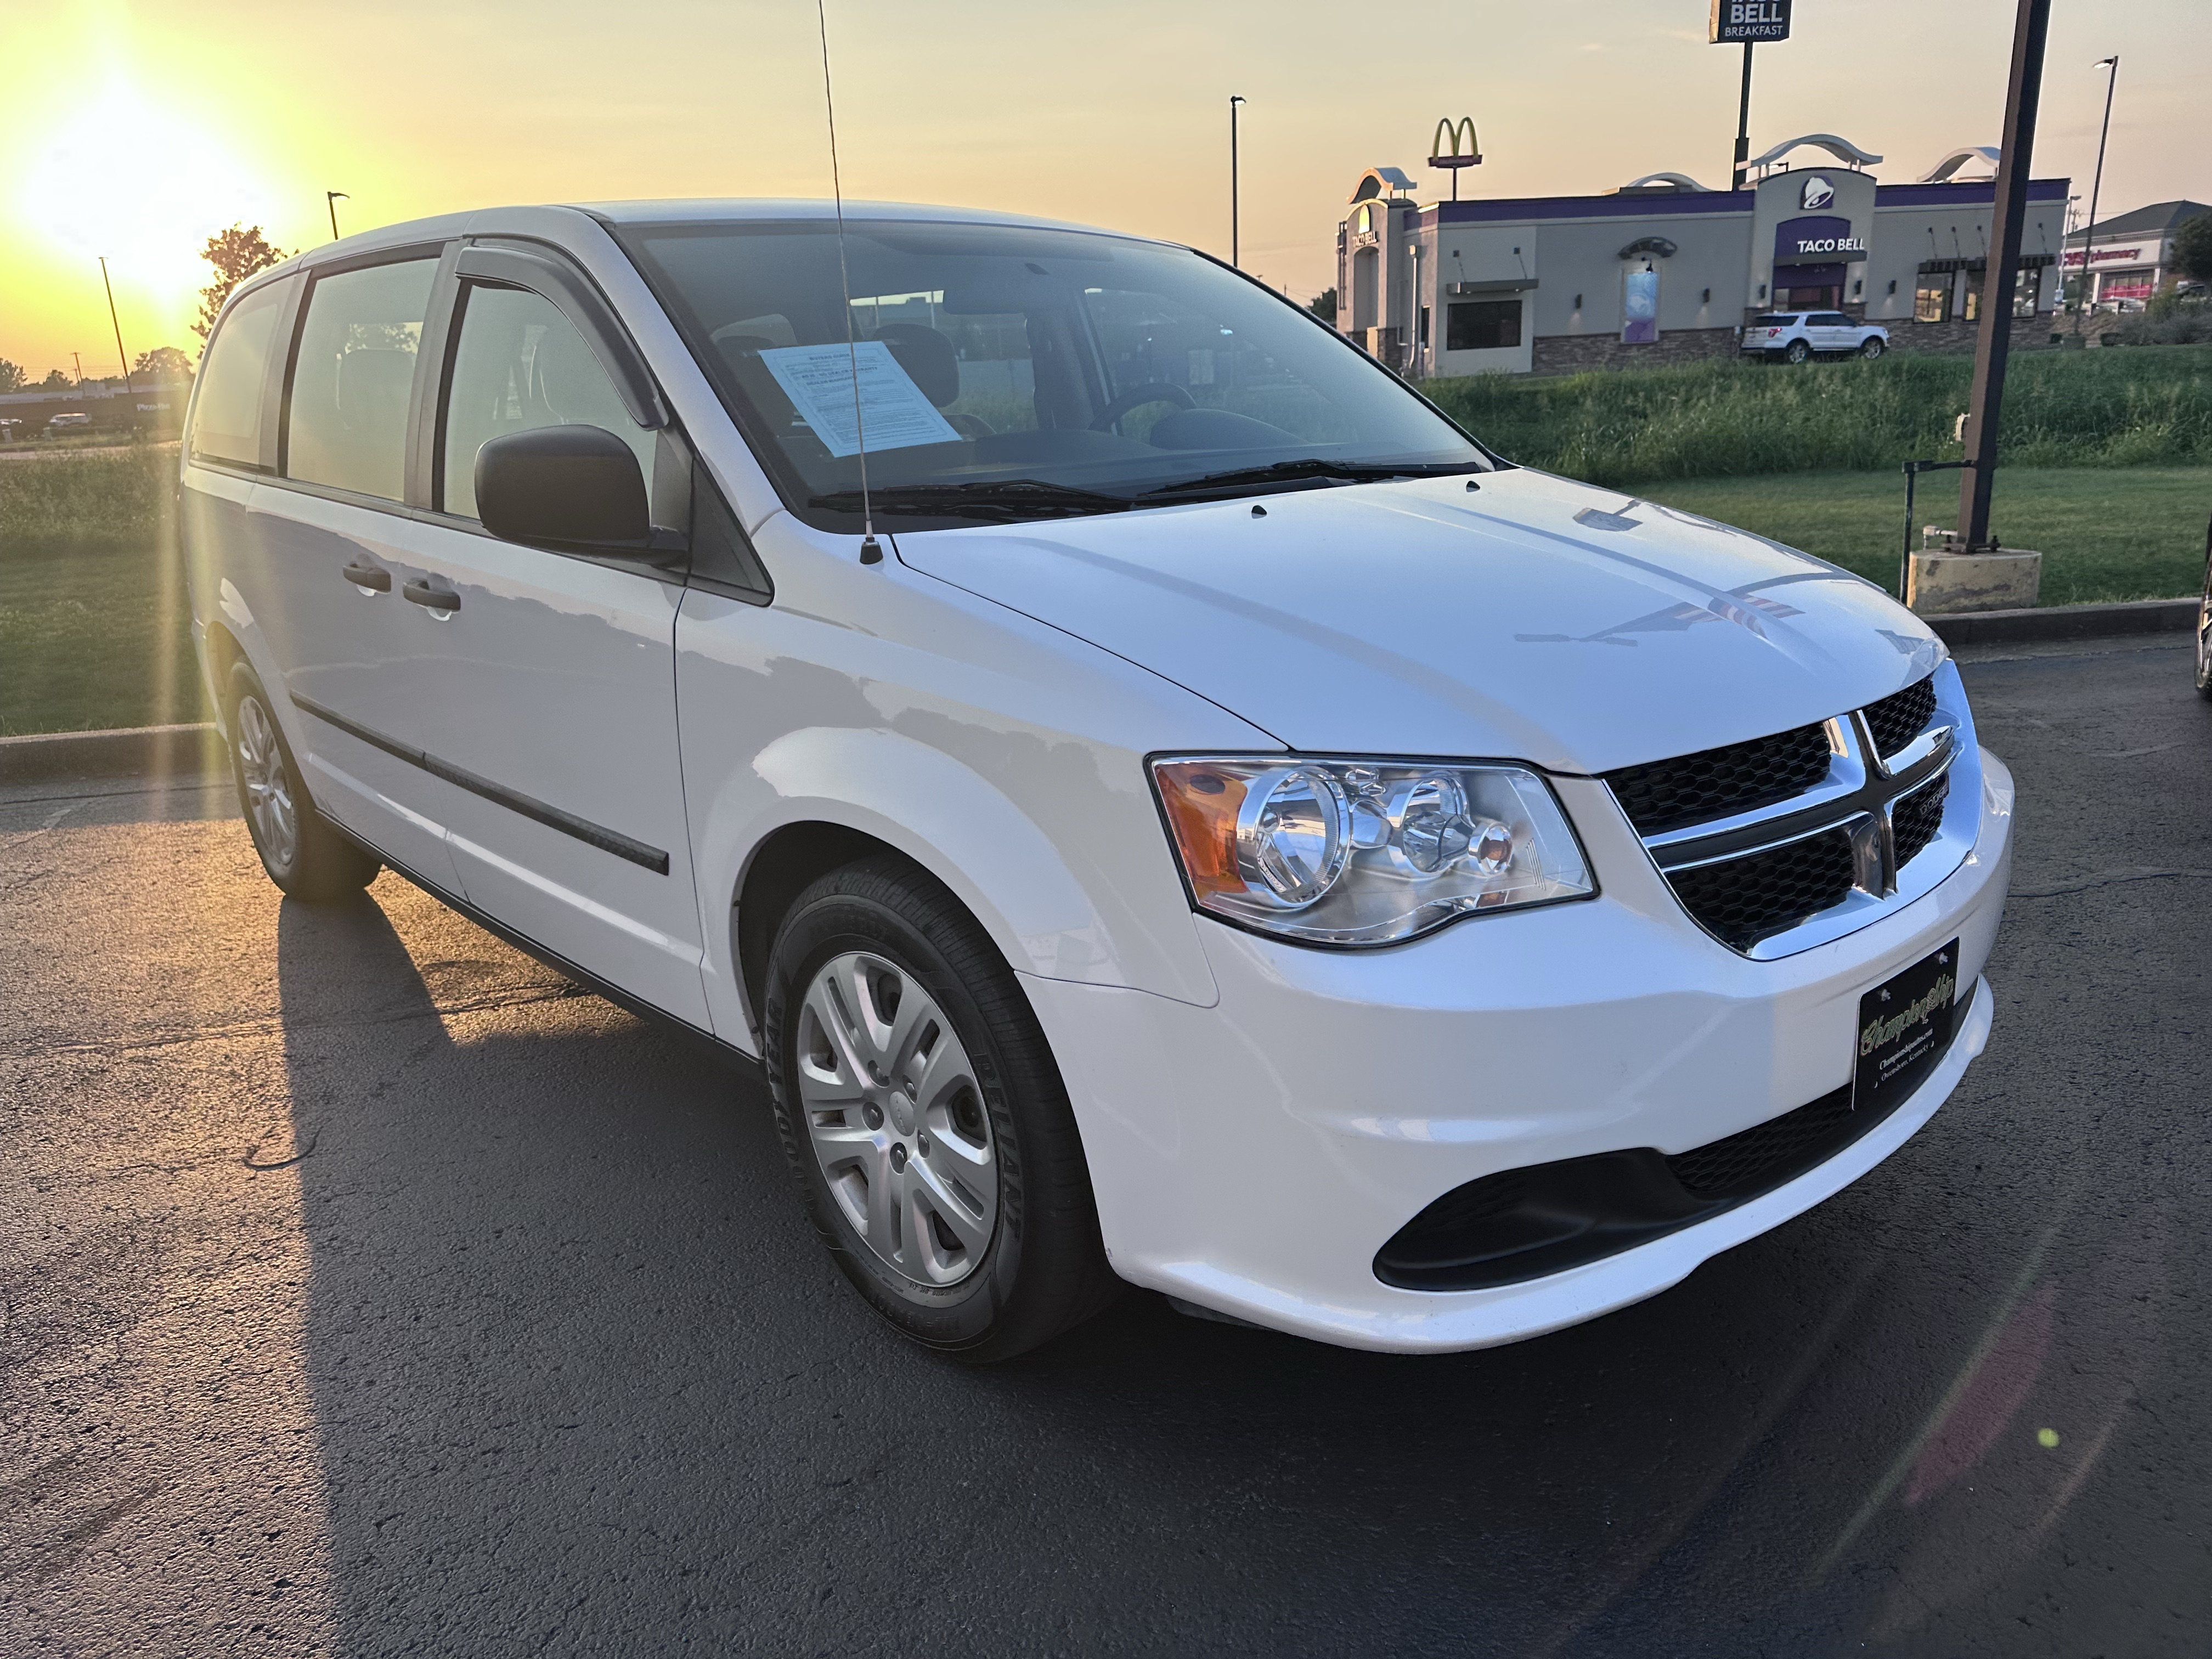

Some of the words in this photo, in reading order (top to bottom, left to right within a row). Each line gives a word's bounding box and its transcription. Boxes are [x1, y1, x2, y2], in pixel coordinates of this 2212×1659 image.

[1731, 3, 1782, 23] BELL
[1725, 25, 1783, 37] BREAKFAST
[1352, 234, 1364, 247] TACO
[1365, 231, 1376, 245] BELL
[1797, 239, 1835, 253] TACO
[1837, 238, 1865, 251] BELL
[974, 1054, 1022, 1241] RELIANT
